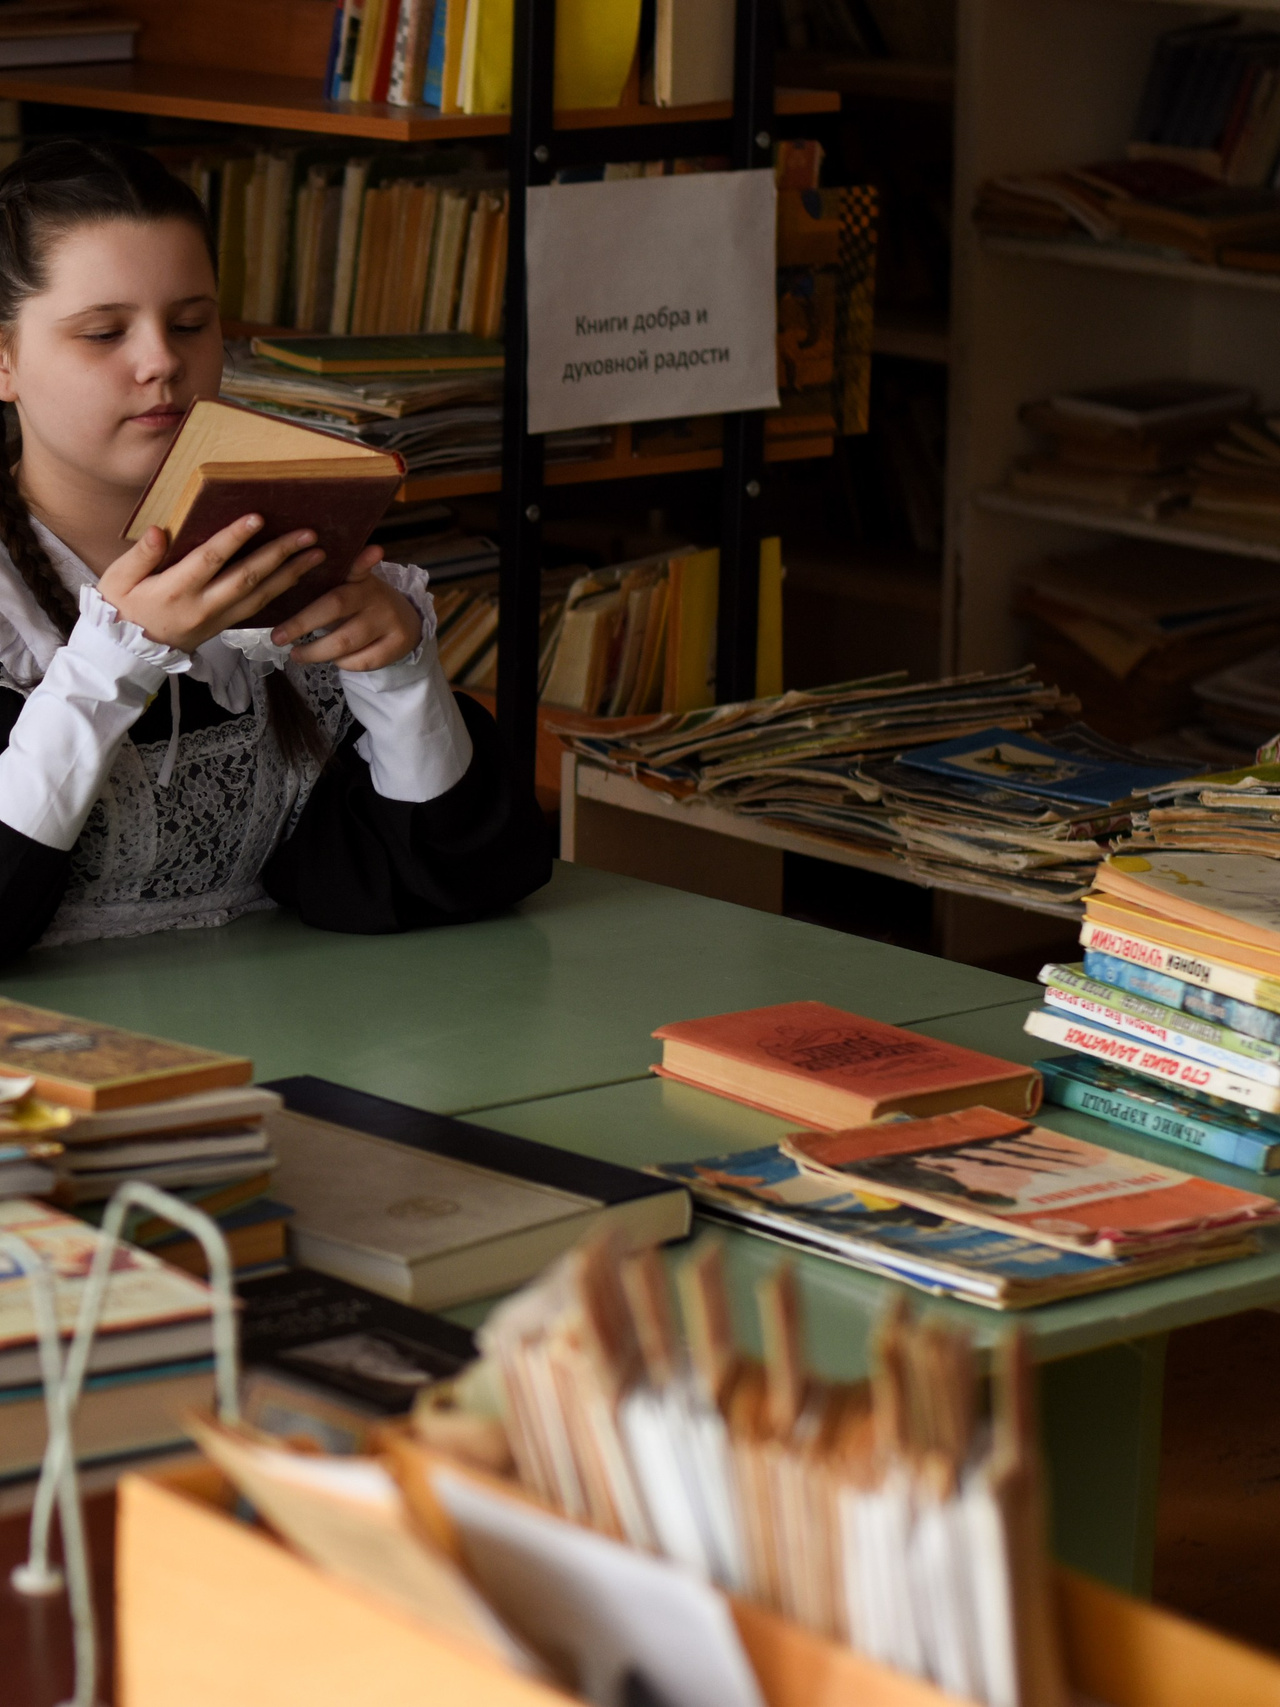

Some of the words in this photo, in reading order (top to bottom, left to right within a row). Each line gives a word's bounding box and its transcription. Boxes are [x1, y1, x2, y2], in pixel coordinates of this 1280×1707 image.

[575, 314, 628, 337] Книги
[632, 305, 691, 334] добра
[696, 307, 709, 326] и
[562, 349, 649, 384] духовной
[654, 346, 731, 374] радости
[1166, 953, 1211, 981] Корней
[1141, 1051, 1180, 1076] ОДИН
[1181, 1061, 1212, 1087] СТО
[1079, 1091, 1150, 1131] КЭРРОЛЛ
[1151, 1120, 1207, 1146] ЛЬЮИС
